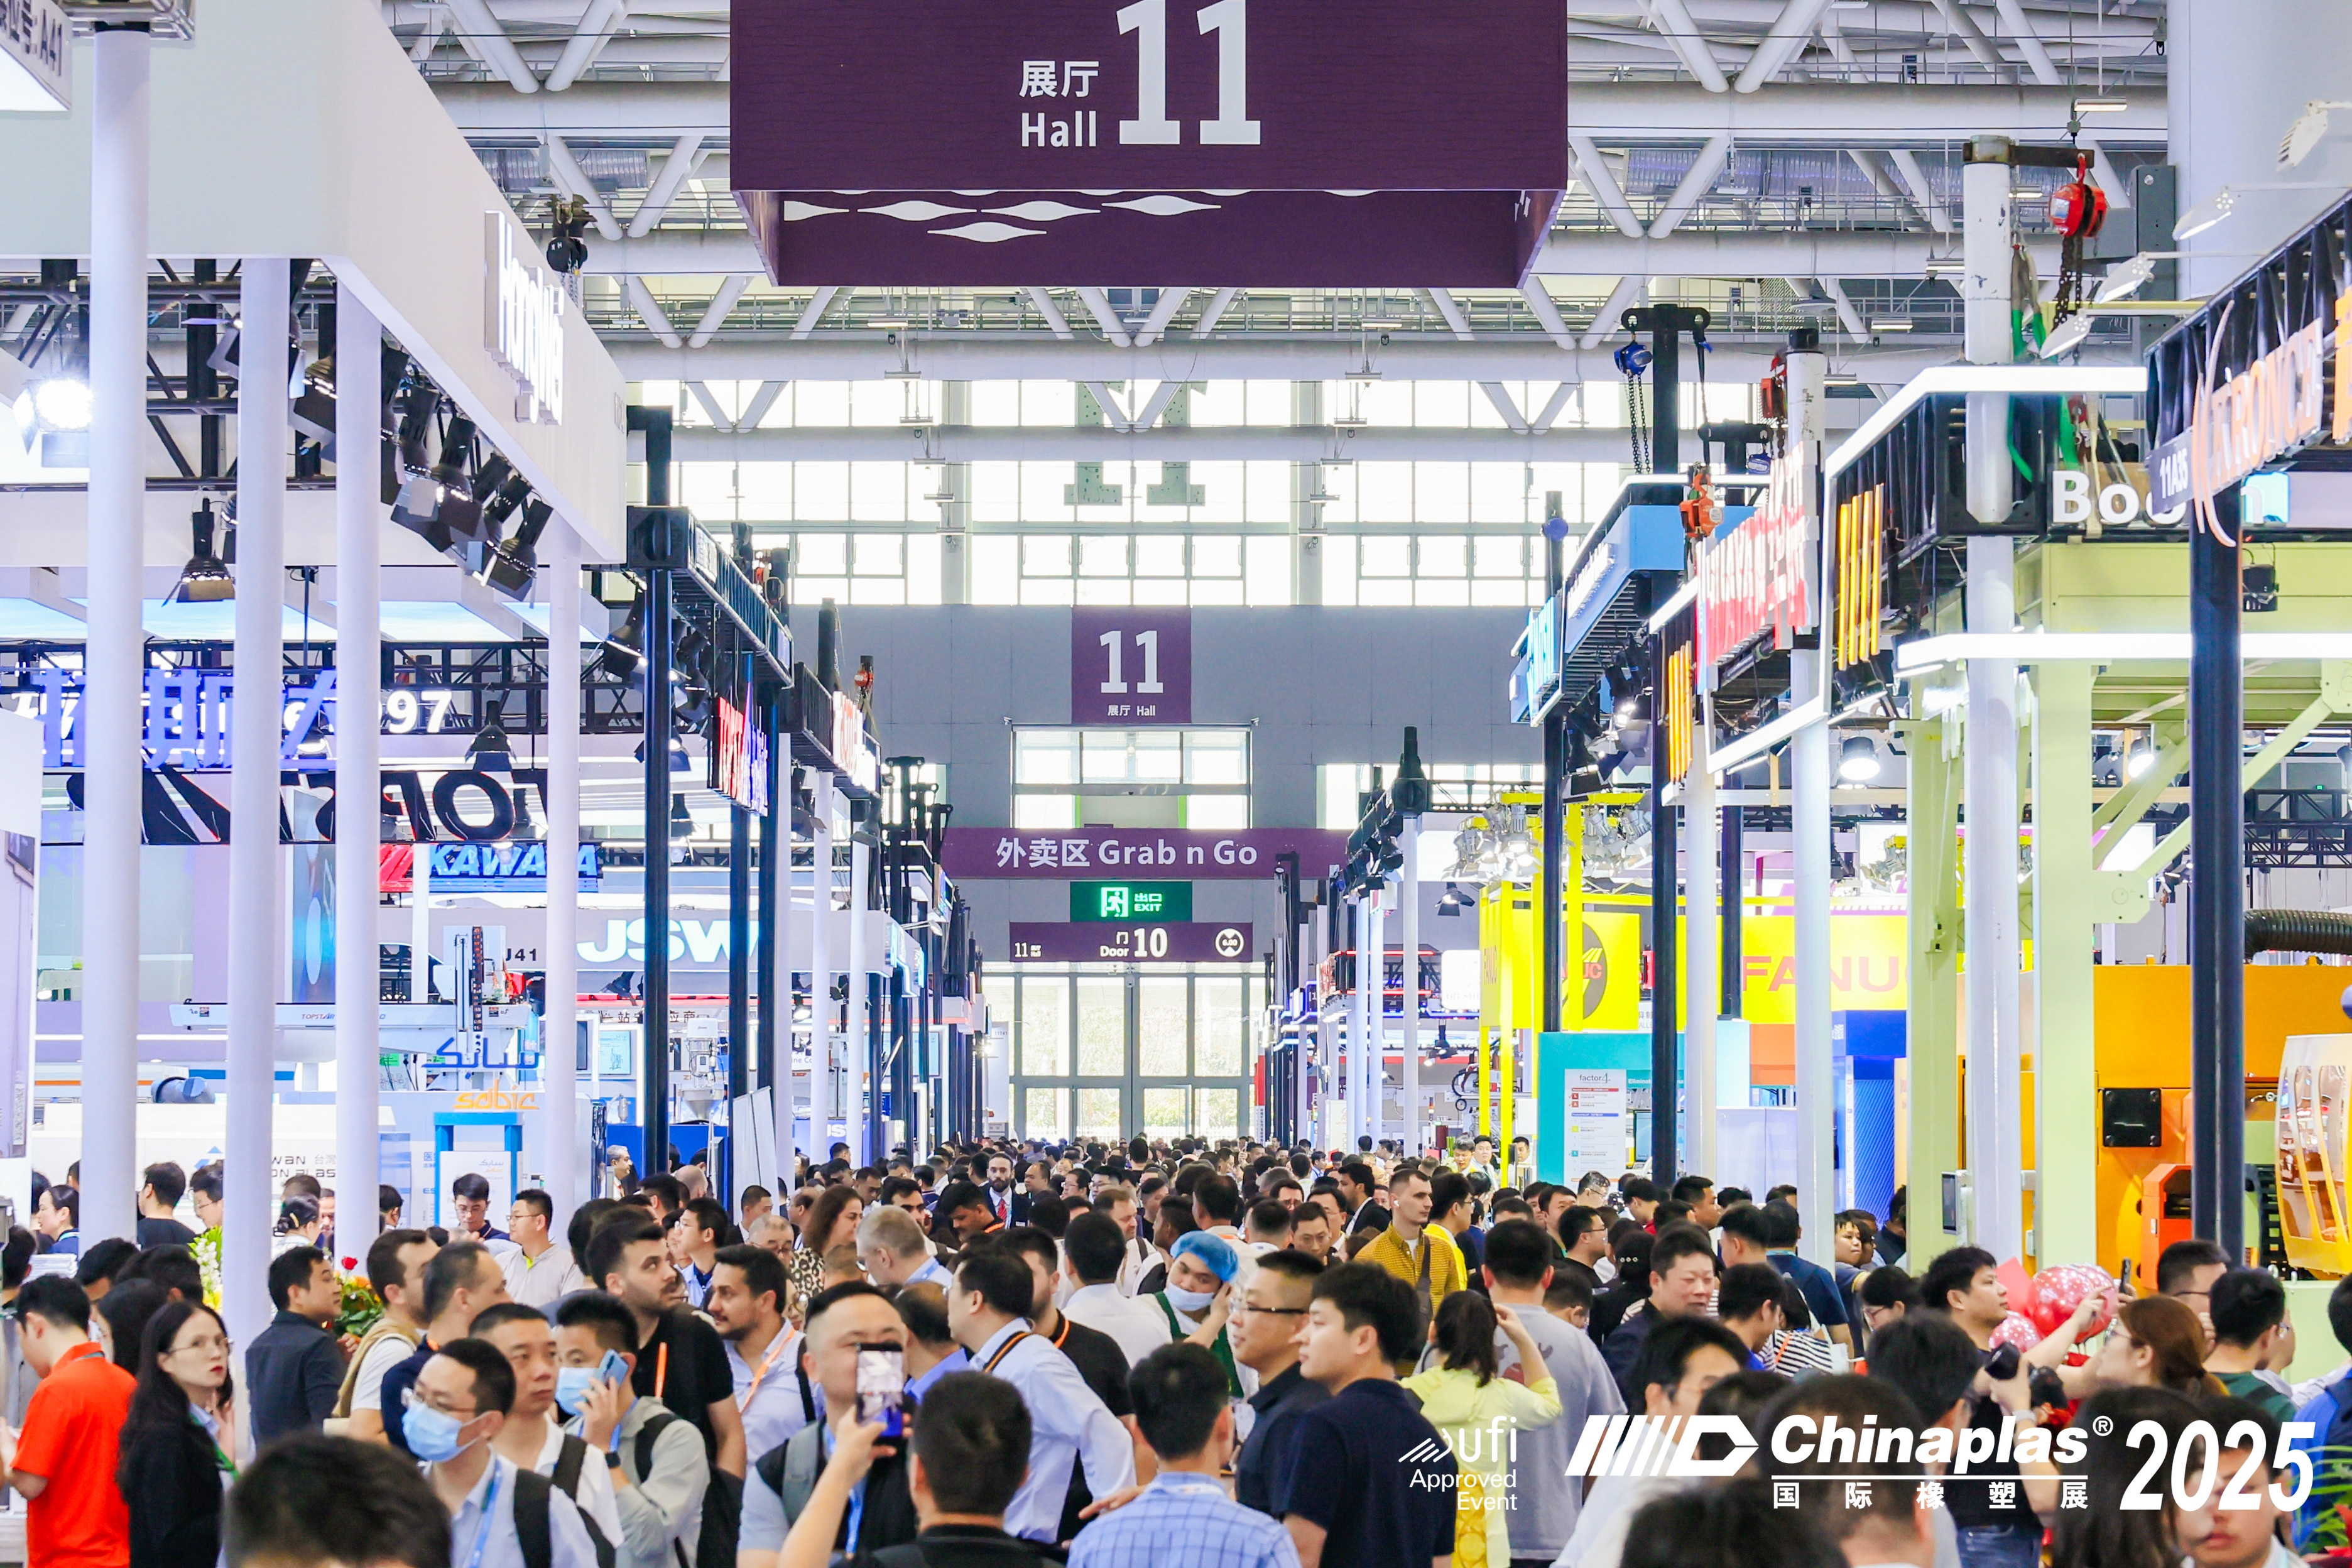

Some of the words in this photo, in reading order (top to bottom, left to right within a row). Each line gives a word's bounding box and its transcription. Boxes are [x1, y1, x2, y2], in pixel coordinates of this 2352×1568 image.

[1019, 61, 1099, 97] 展厅
[1116, 0, 1261, 144] 11
[1021, 110, 1096, 147] Hall
[2159, 449, 2188, 499] 11A35
[1099, 630, 1163, 694] 11
[1108, 705, 1131, 716] 展厅
[1136, 705, 1155, 716] Hall
[430, 844, 597, 876] KAWAA
[996, 837, 1090, 868] 外卖区
[1098, 839, 1176, 865] Grab
[1187, 846, 1204, 864] n
[1214, 840, 1257, 865] Go
[1135, 893, 1162, 902] 出口
[1135, 903, 1162, 912] EXIT
[577, 917, 760, 962] JSW
[1015, 942, 1028, 957] 11
[1099, 945, 1130, 957] Door
[1134, 927, 1168, 958] 10
[1116, 931, 1129, 944] 门
[1742, 956, 1908, 993] FANU
[453, 1079, 539, 1110] sabic
